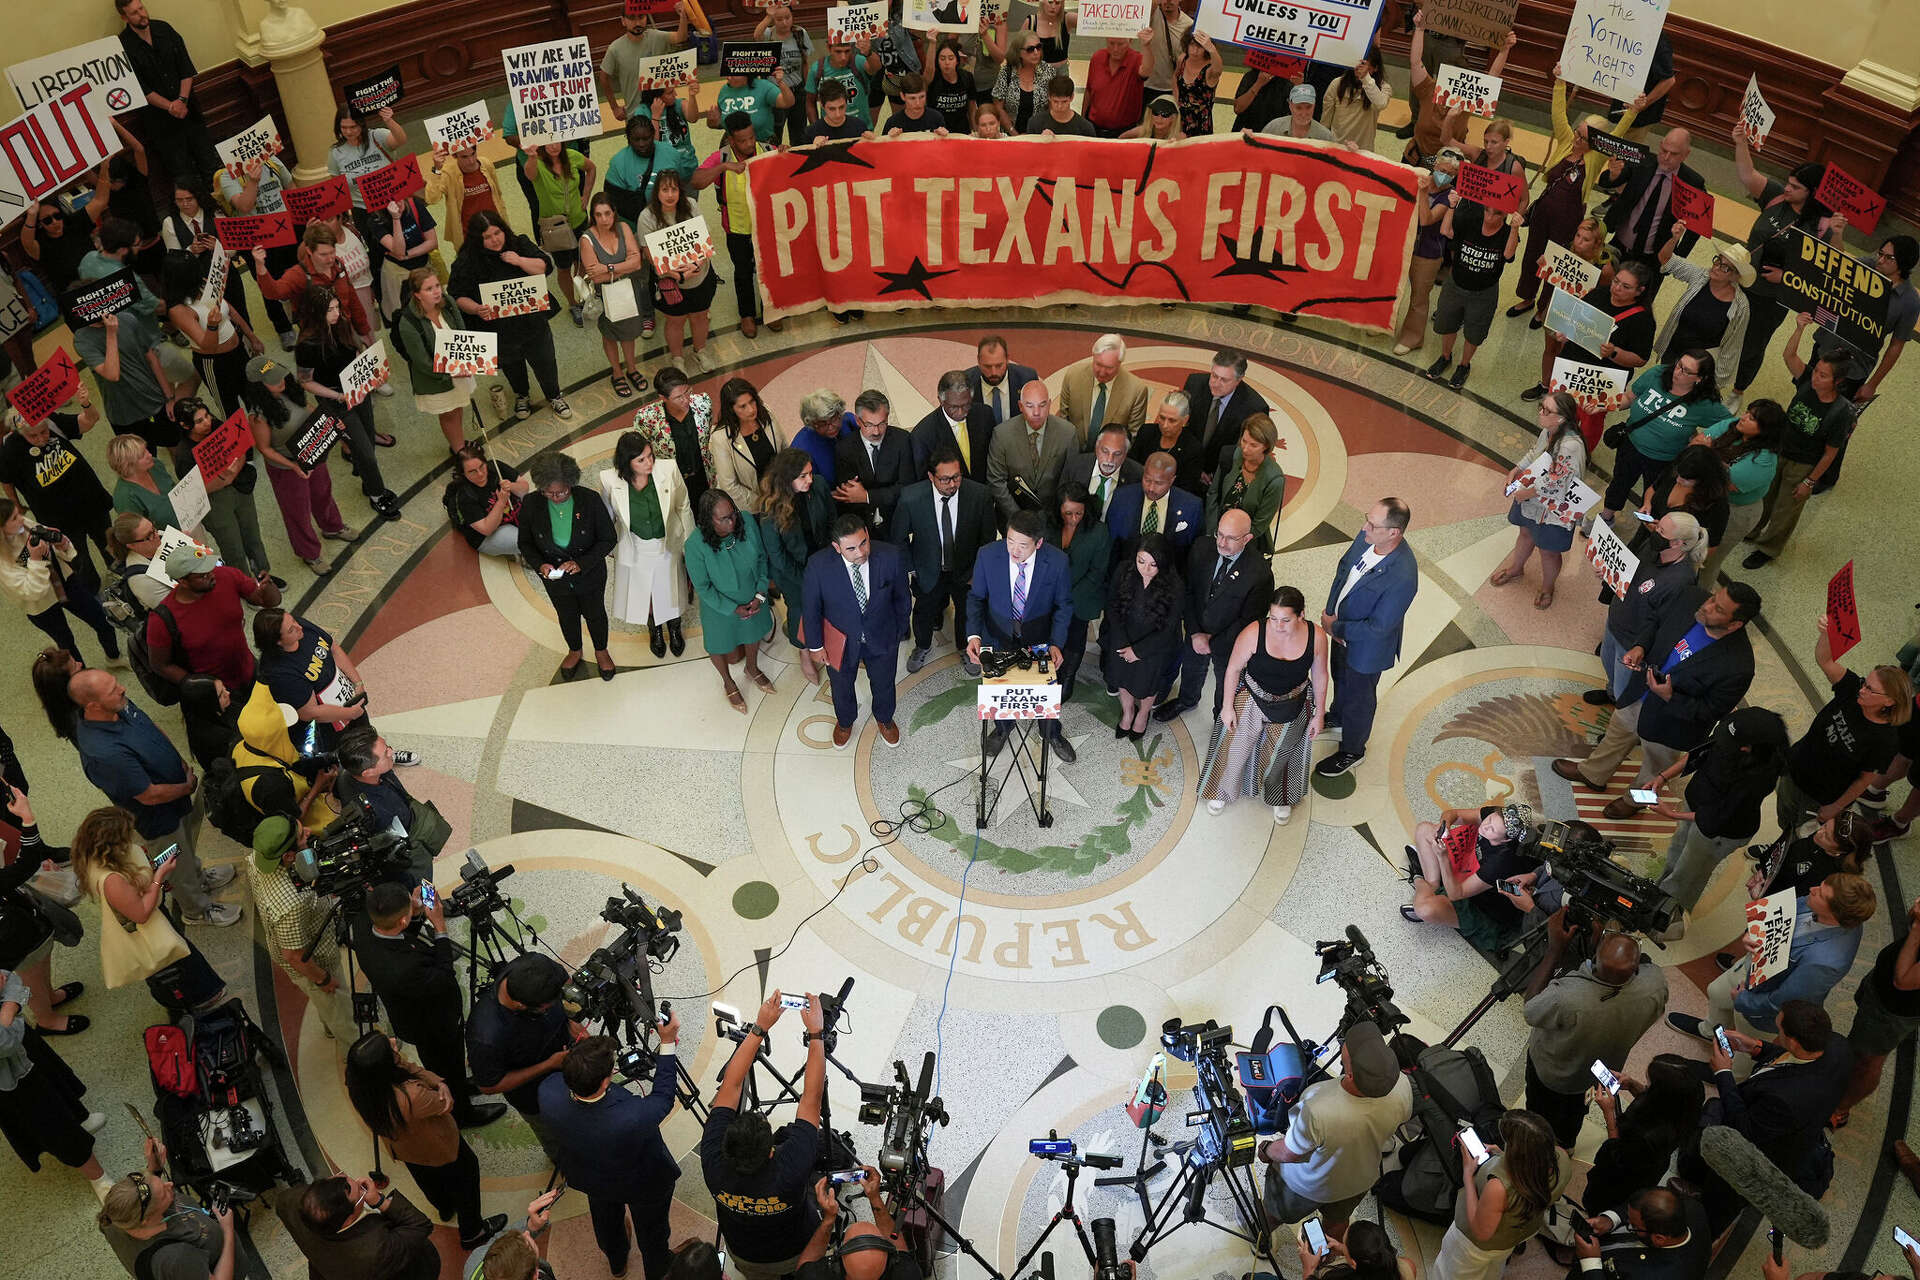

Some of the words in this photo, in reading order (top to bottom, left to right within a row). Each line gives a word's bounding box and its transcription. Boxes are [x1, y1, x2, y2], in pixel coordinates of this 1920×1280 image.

[838, 13, 879, 25] TEXANS
[848, 7, 868, 16] PUT
[1081, 3, 1145, 20] TAKEOVER!
[1234, 0, 1299, 21] UNLESS
[1308, 12, 1341, 29] YOU
[1608, 1, 1636, 21] the
[844, 21, 873, 32] FIRST
[1245, 24, 1309, 48] CHEAT?
[1588, 14, 1643, 56] VOTING
[507, 48, 536, 70] WHY
[542, 46, 564, 64] ARE
[569, 44, 586, 58] WE
[649, 61, 689, 73] TEXANS
[660, 56, 679, 65] PUT
[1582, 45, 1635, 77] RIGHTS
[510, 64, 559, 87] DRAWING
[563, 60, 592, 78] MAPS
[655, 70, 682, 79] FIRST
[1459, 72, 1480, 85] PUT
[1592, 70, 1620, 92] ACT
[355, 83, 378, 97] FIGHT
[379, 76, 394, 88] THE
[519, 85, 547, 104] FOR
[550, 77, 591, 98] TRUMP
[1447, 77, 1489, 96] TEXANS
[1452, 87, 1481, 101] FIRST
[360, 94, 398, 114] TAKEOVER
[524, 97, 574, 119] INSTEAD
[579, 94, 594, 110] OF
[438, 115, 480, 137] TEXANS
[447, 112, 467, 124] PUT
[522, 120, 548, 137] FOR
[550, 110, 601, 132] TEXANS
[0, 82, 109, 201] OUT
[237, 129, 257, 146] PUT
[447, 125, 476, 142] FIRST
[230, 131, 270, 158] TEXANS
[241, 141, 266, 161] FIRST
[363, 174, 395, 190] LETTING
[1462, 170, 1493, 185] LETTING
[1462, 176, 1487, 188] TRUMP
[365, 183, 393, 196] TRUMP
[367, 191, 388, 201] TAKE
[389, 181, 408, 194] OVER
[1460, 181, 1480, 192] TAKE
[1481, 189, 1501, 199] OVER
[666, 226, 686, 239] PUT
[770, 178, 892, 277] PUT
[914, 176, 1181, 265] TEXANS
[1201, 171, 1397, 281] FIRST
[657, 229, 700, 251] TEXANS
[667, 242, 695, 257] FIRST
[1552, 255, 1589, 282] TEXANS
[1563, 254, 1583, 268] PUT
[1801, 235, 1884, 298] DEFEND
[1554, 266, 1582, 285] FIRST
[77, 289, 106, 304] FIGHT
[106, 279, 125, 291] THE
[492, 286, 537, 300] TEXANS
[502, 281, 523, 291] PUT
[1823, 273, 1855, 304] THE
[83, 297, 132, 321] TAKEOVER
[500, 295, 530, 307] FIRST
[1783, 271, 1882, 339] CONSTITUTION
[444, 342, 487, 353] TEXANS
[454, 334, 475, 343] PUT
[353, 354, 368, 371] PUT
[450, 351, 479, 361] FIRST
[348, 356, 379, 385] TEXANS
[354, 367, 374, 389] FIRST
[1563, 371, 1614, 389] TEXANS
[1577, 366, 1603, 378] PUT
[17, 378, 50, 403] LETTING
[22, 388, 49, 409] TRUMP
[26, 396, 48, 414] TAKE
[48, 381, 68, 397] OVER
[1568, 382, 1605, 395] FIRST
[297, 426, 316, 449] FIGHT
[315, 413, 327, 427] THE
[307, 430, 338, 465] TAKEOVER
[159, 542, 174, 562] PUT
[1597, 534, 1627, 572] TEXANS
[1606, 534, 1622, 554] PUT
[1598, 548, 1619, 573] FIRST
[315, 517, 427, 628] FRANC
[1825, 724, 1838, 744] NO
[804, 823, 1158, 969] REPUBLIC
[1763, 919, 1774, 959] FIRST
[1770, 906, 1783, 965] TEXANS
[1783, 917, 1792, 945] PUT
[720, 1190, 780, 1205] TEXAS
